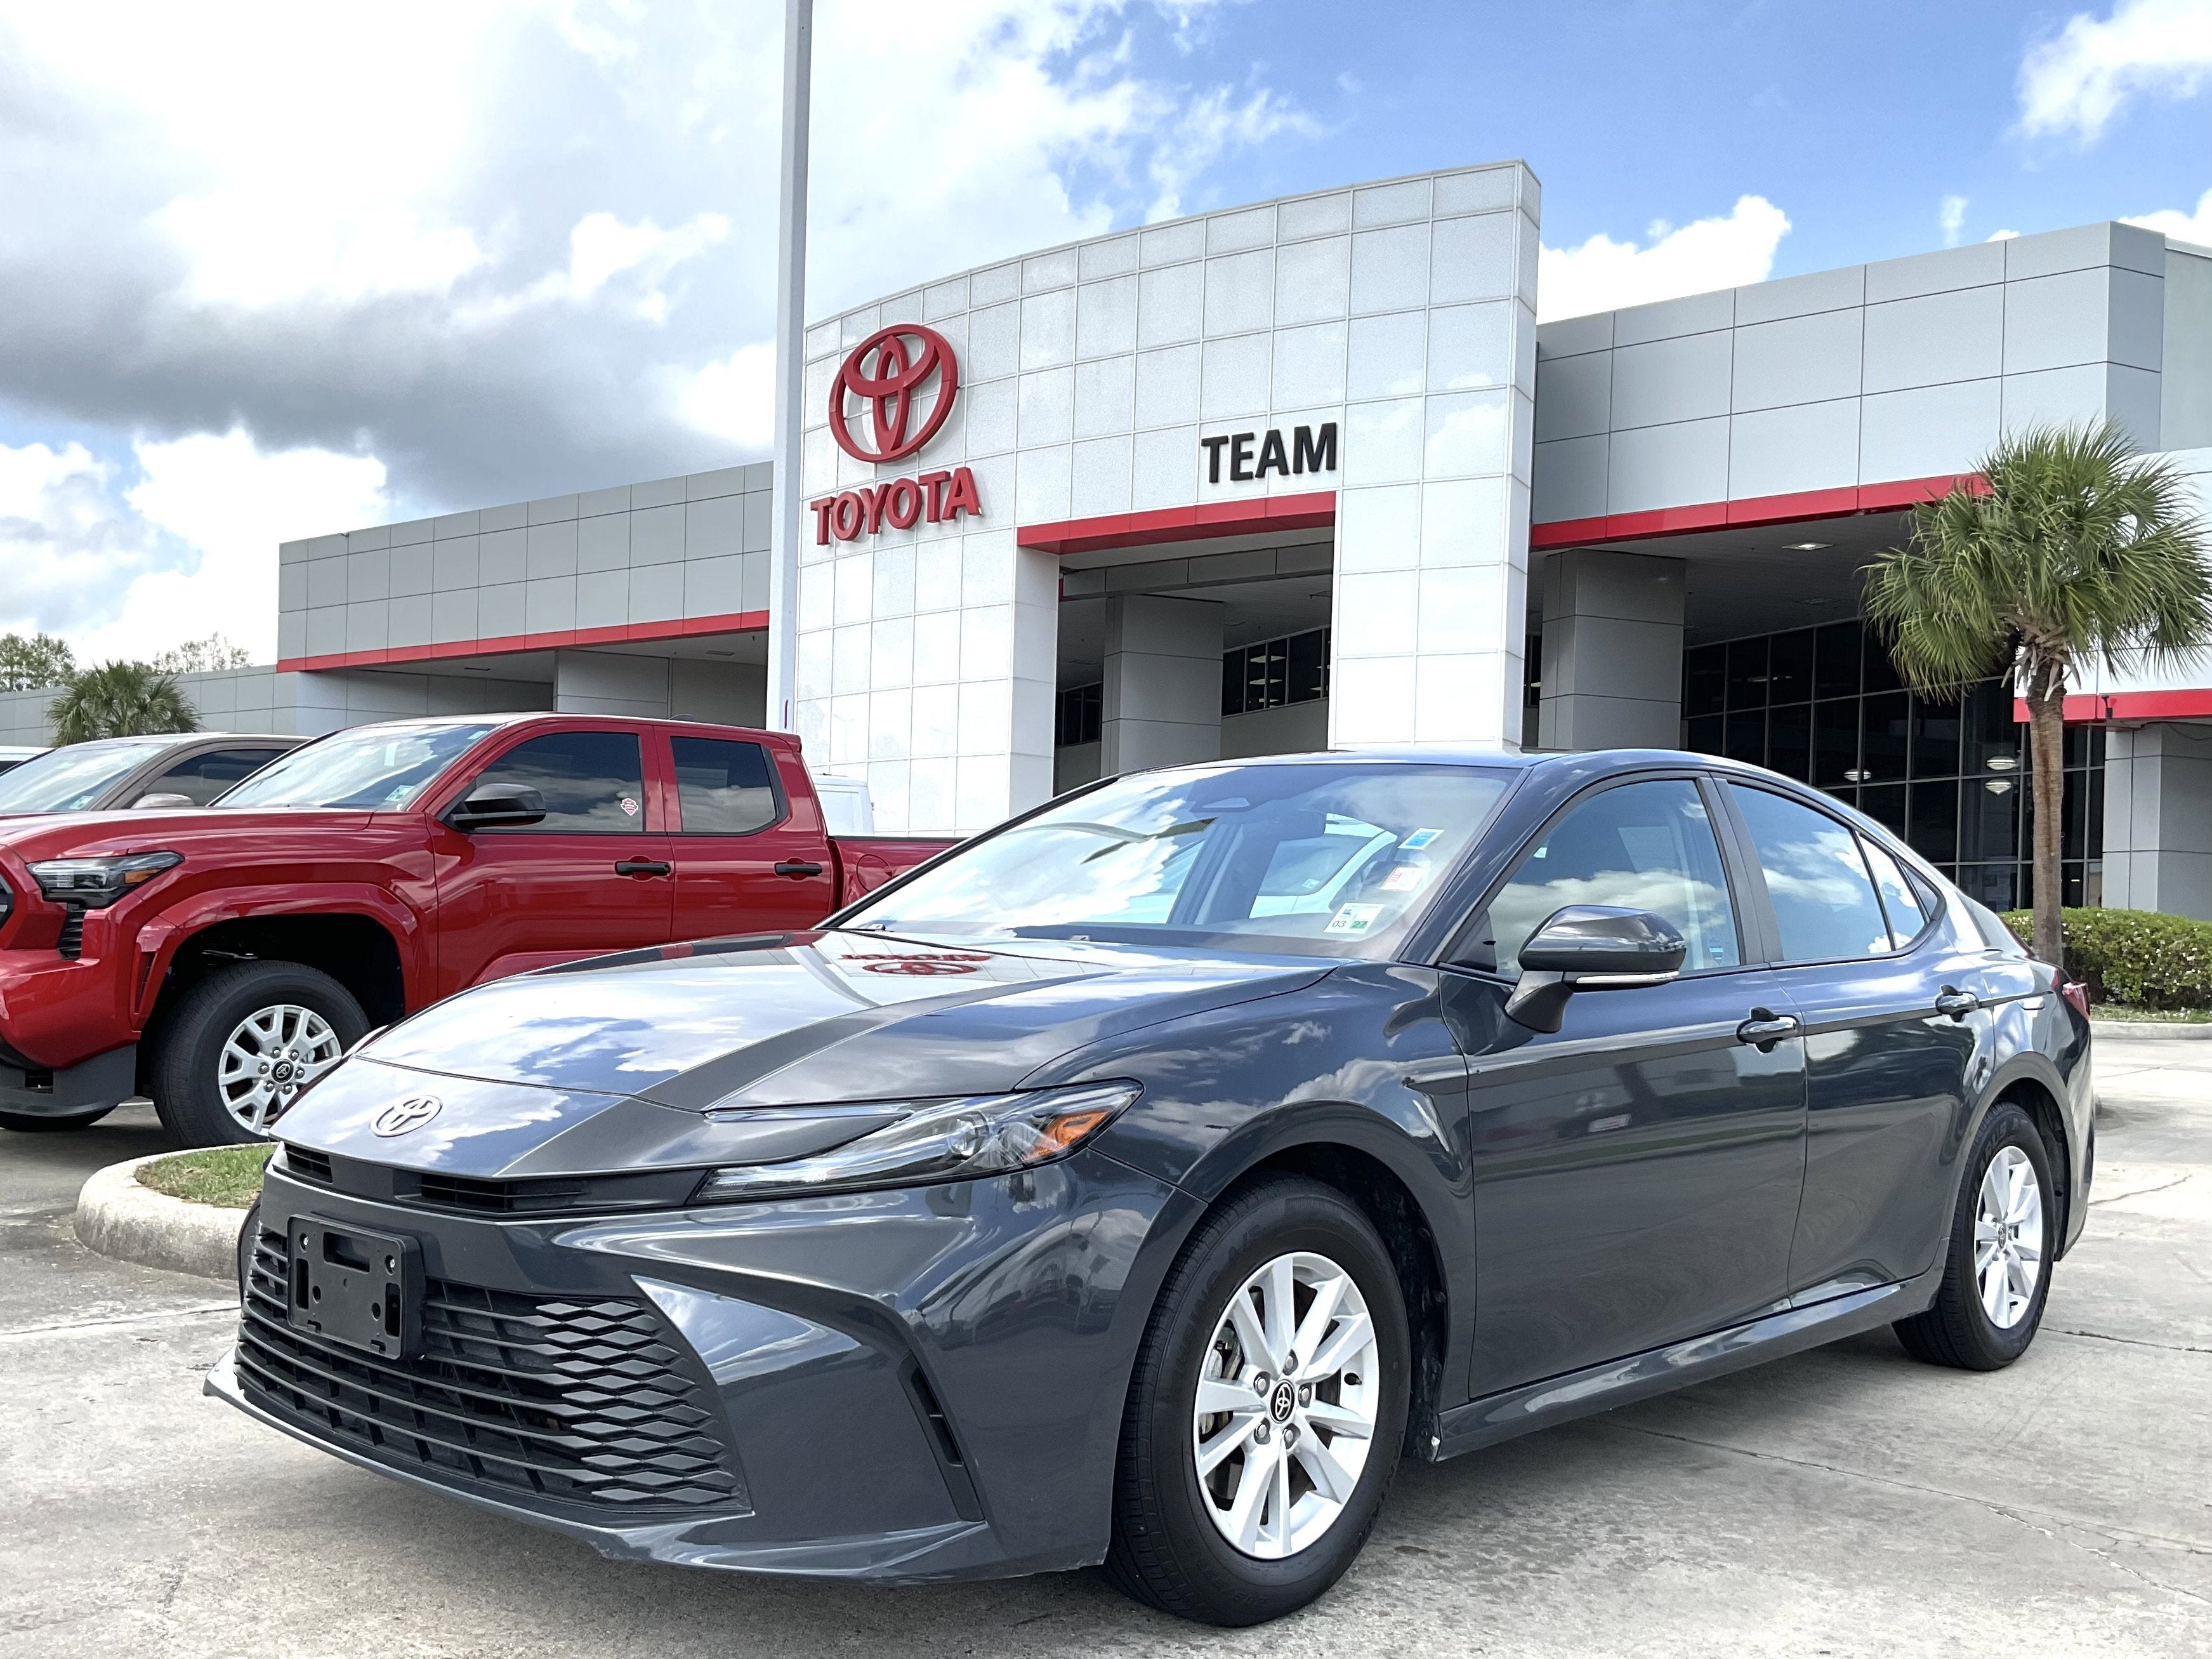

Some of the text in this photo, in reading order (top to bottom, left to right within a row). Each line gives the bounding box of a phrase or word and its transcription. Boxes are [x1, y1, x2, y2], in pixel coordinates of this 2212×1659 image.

[1201, 422, 1336, 482] TEAM
[810, 467, 982, 545] TOYOTA
[1352, 920, 1368, 929] 27
